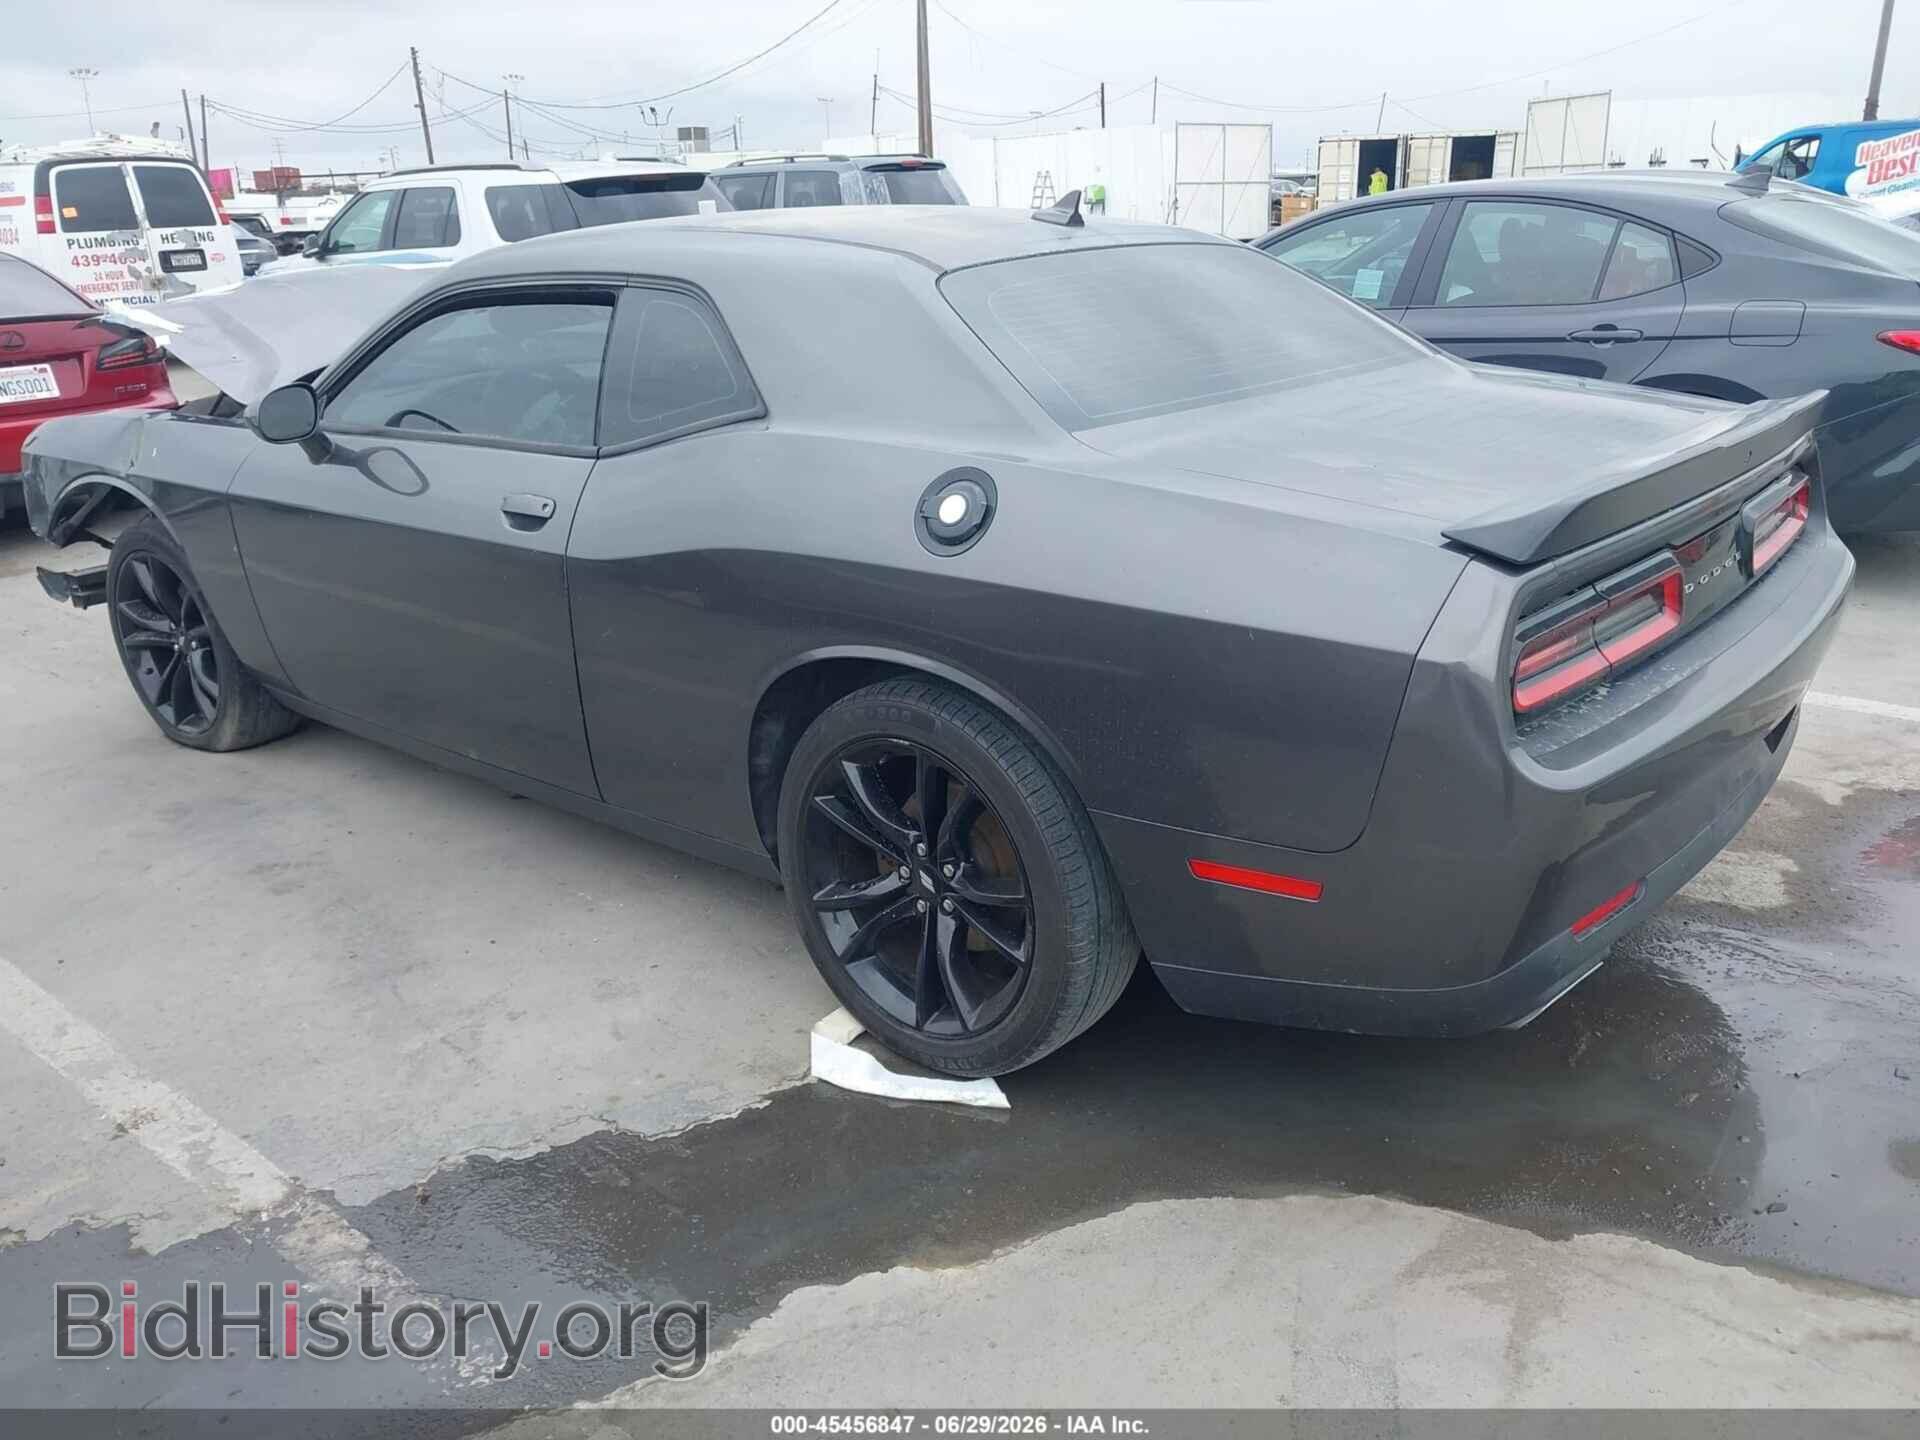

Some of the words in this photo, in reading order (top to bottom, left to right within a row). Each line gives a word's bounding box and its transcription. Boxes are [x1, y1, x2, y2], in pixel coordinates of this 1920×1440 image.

[1866, 151, 1920, 186] Best
[66, 235, 140, 250] PLUMBING
[160, 231, 215, 245] HEING
[1684, 551, 1741, 594] DODGE
